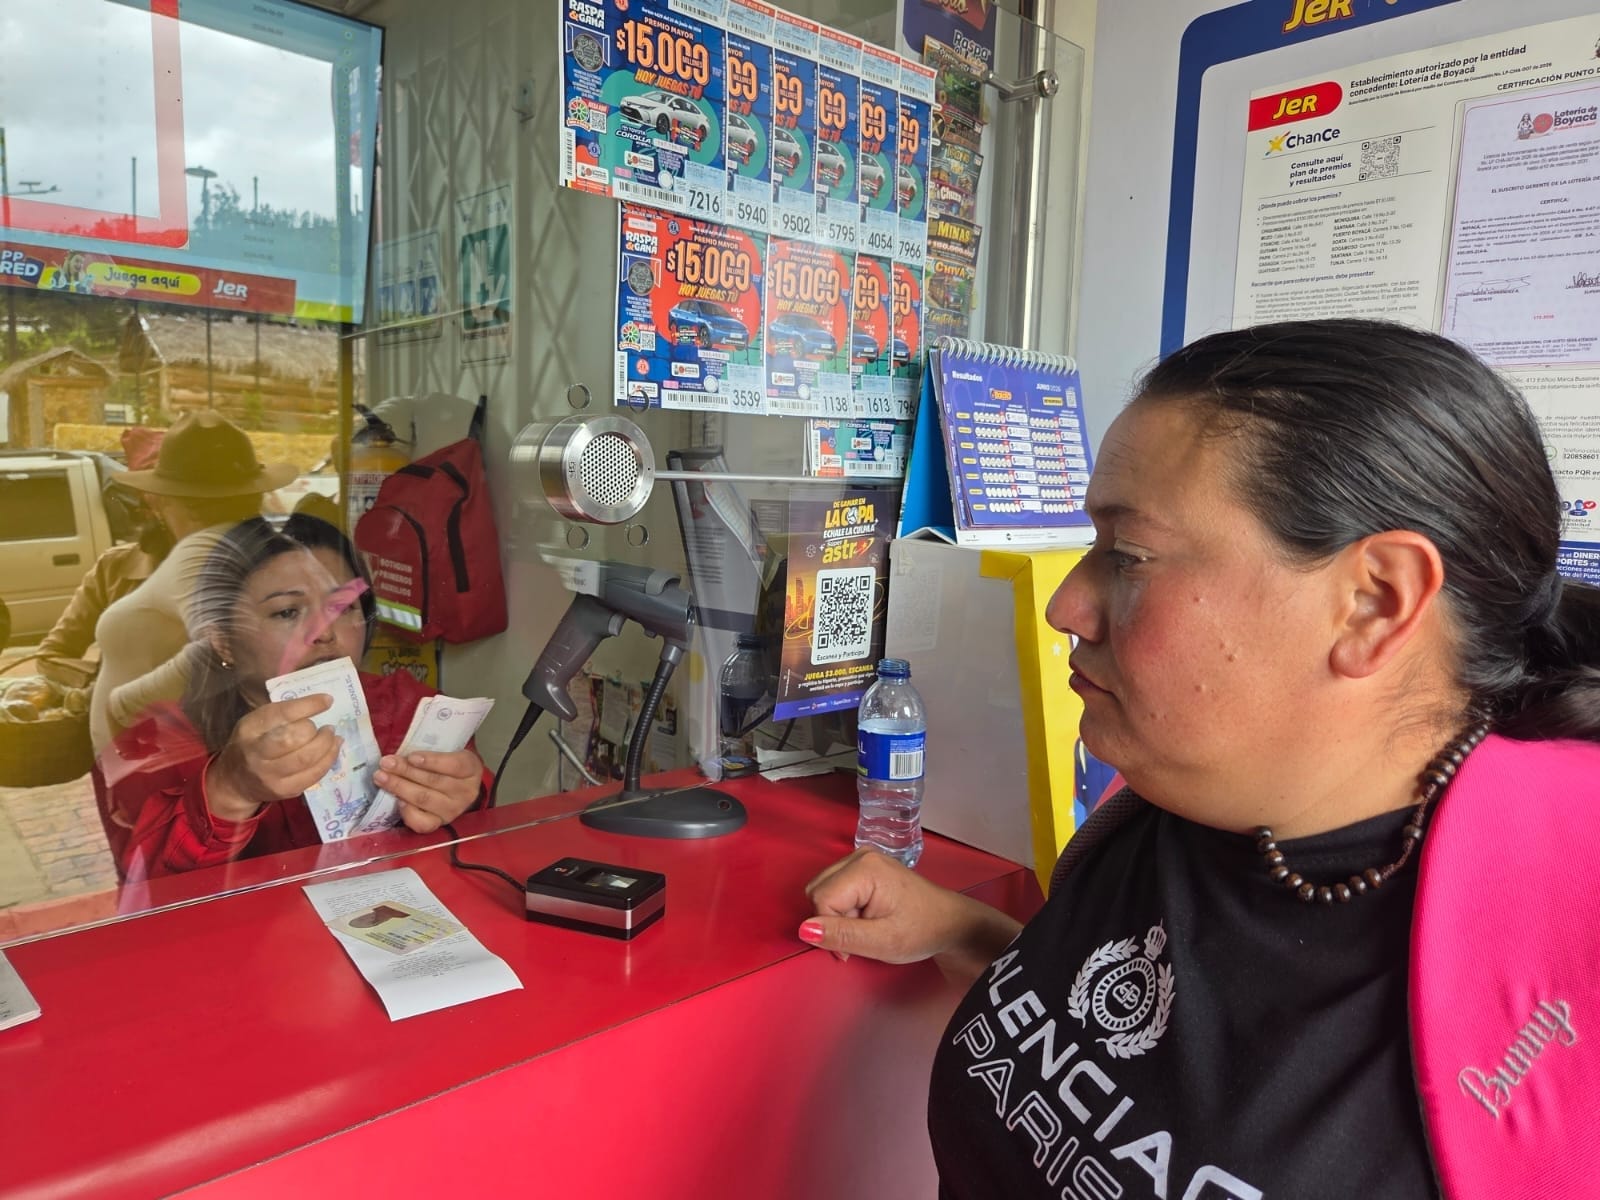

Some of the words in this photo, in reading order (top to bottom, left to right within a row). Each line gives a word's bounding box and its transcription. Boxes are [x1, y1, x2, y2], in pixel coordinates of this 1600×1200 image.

[569, 0, 605, 20] RASPA
[644, 17, 670, 32] PREMIO
[670, 26, 694, 41] MAYOR
[616, 20, 710, 86] $15.000
[952, 30, 991, 62] Raspa
[1350, 67, 1414, 88] Establecimiento
[1415, 58, 1461, 76] autorizado
[1462, 55, 1478, 68] por
[1480, 52, 1488, 62] la
[1489, 45, 1526, 60] entidad
[635, 70, 656, 85] HOY
[656, 75, 688, 94] JUEGAS
[1349, 81, 1398, 98] concedente:
[1399, 73, 1429, 87] Lotería
[1430, 70, 1442, 81] de
[1443, 65, 1476, 80] Boyacá
[1497, 73, 1562, 91] CERTIFICACIÓN
[1564, 68, 1595, 80] PUNTO
[1553, 112, 1598, 127] Boyacá
[1554, 106, 1587, 119] Lotería
[1290, 170, 1306, 179] plan
[1308, 167, 1318, 175] de
[1320, 162, 1352, 174] premios
[1291, 158, 1324, 170] Consulte
[1326, 154, 1344, 165] aquí
[1296, 173, 1336, 185] resultados
[689, 190, 719, 213] 7216
[737, 202, 767, 224] 5940
[782, 214, 811, 235] 9502
[828, 223, 855, 244] 5795
[937, 220, 971, 242] MINAS
[625, 231, 658, 246] RASPA
[694, 235, 718, 246] PREMIO
[718, 240, 738, 250] MAYOR
[867, 232, 893, 251] 4054
[899, 240, 921, 258] 7966
[0, 263, 39, 280] RED
[666, 240, 751, 291] $15.000
[103, 267, 147, 291] Juega
[151, 274, 181, 292] aquí
[679, 283, 695, 296] HOY
[695, 286, 726, 301] JUEGAS
[777, 300, 792, 311] HOY
[792, 302, 820, 315] JUEGAS
[951, 370, 983, 383] Resultados
[731, 390, 761, 408] 3539
[823, 396, 848, 412] 1138
[867, 397, 890, 413] 1613
[896, 399, 916, 413] 796
[825, 509, 841, 528] LA
[1574, 552, 1600, 560] DINER
[380, 558, 413, 573] BOTIQUIN
[379, 570, 413, 586] PRIMEROS
[817, 653, 838, 662] Escanea
[842, 650, 865, 660] Participa
[805, 671, 825, 681] JUEGA
[848, 664, 874, 674] ESCANEA
[325, 819, 344, 840] 50
[1458, 996, 1579, 1119] Bunny
